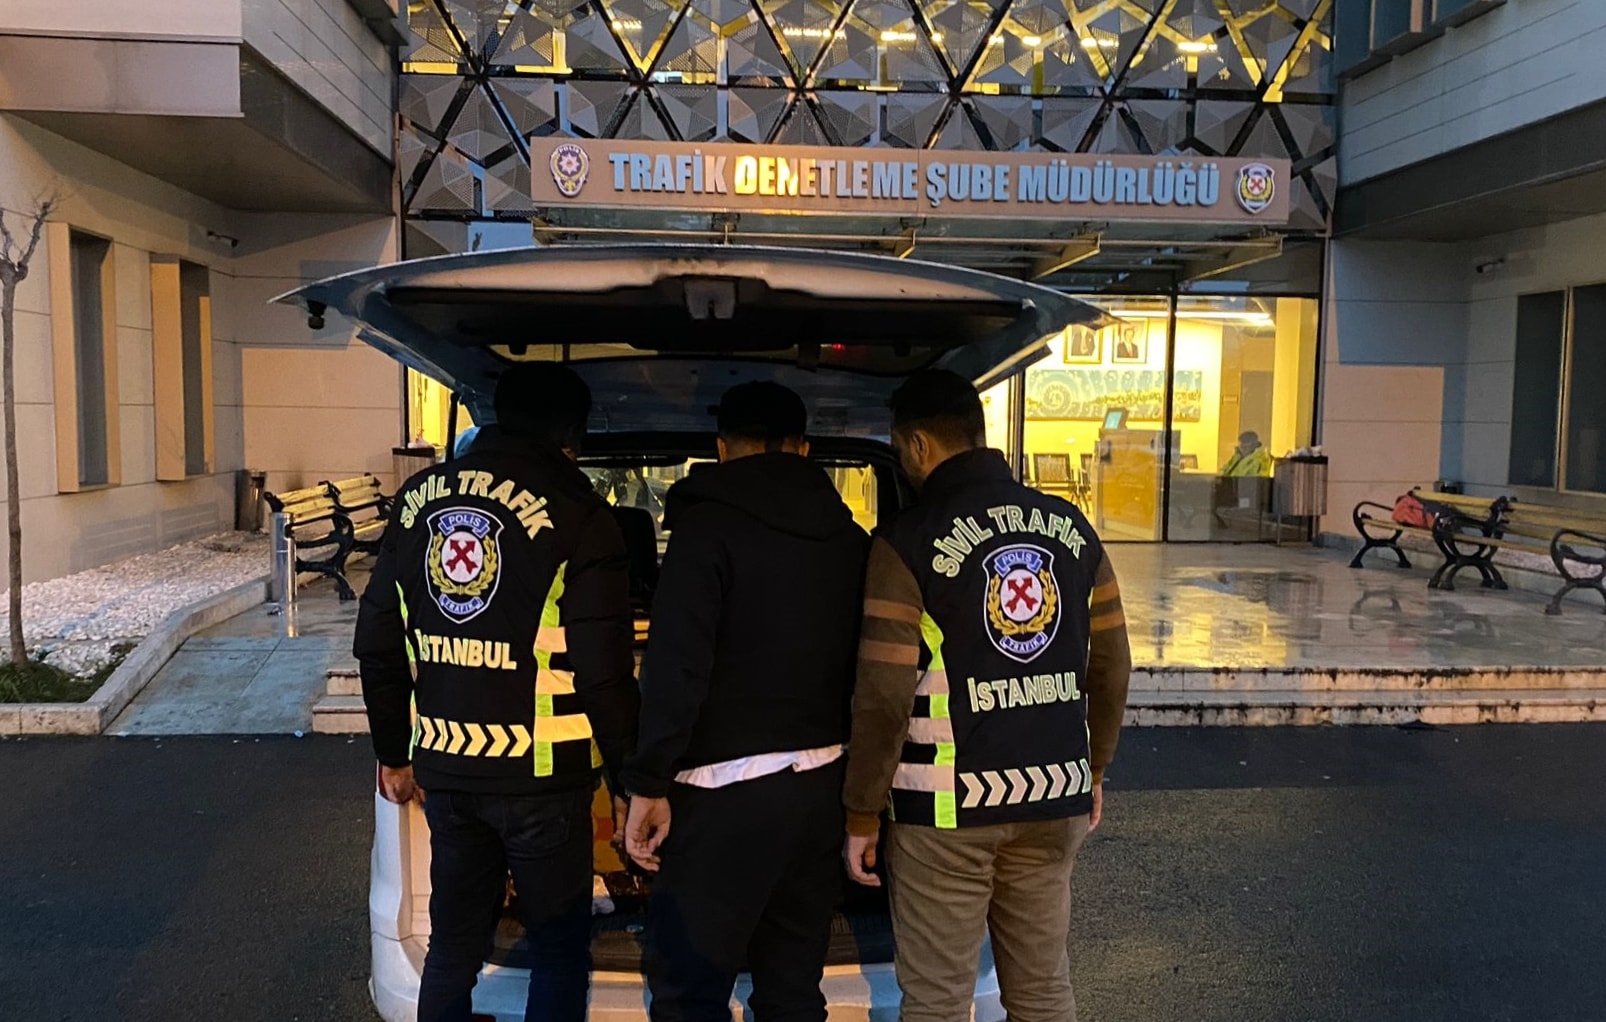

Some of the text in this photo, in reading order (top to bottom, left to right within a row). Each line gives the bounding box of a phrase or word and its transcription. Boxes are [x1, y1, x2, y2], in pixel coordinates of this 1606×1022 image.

[609, 149, 1220, 207] TRAFİK DENETLEME ŞUBE MÜDÜRLÜĞÜ
[458, 470, 555, 540] TRAFİK
[932, 505, 1087, 578] SİVİL TRAFİK
[414, 628, 517, 670] İSTANBUL
[967, 671, 1080, 713] İSTANBUL
